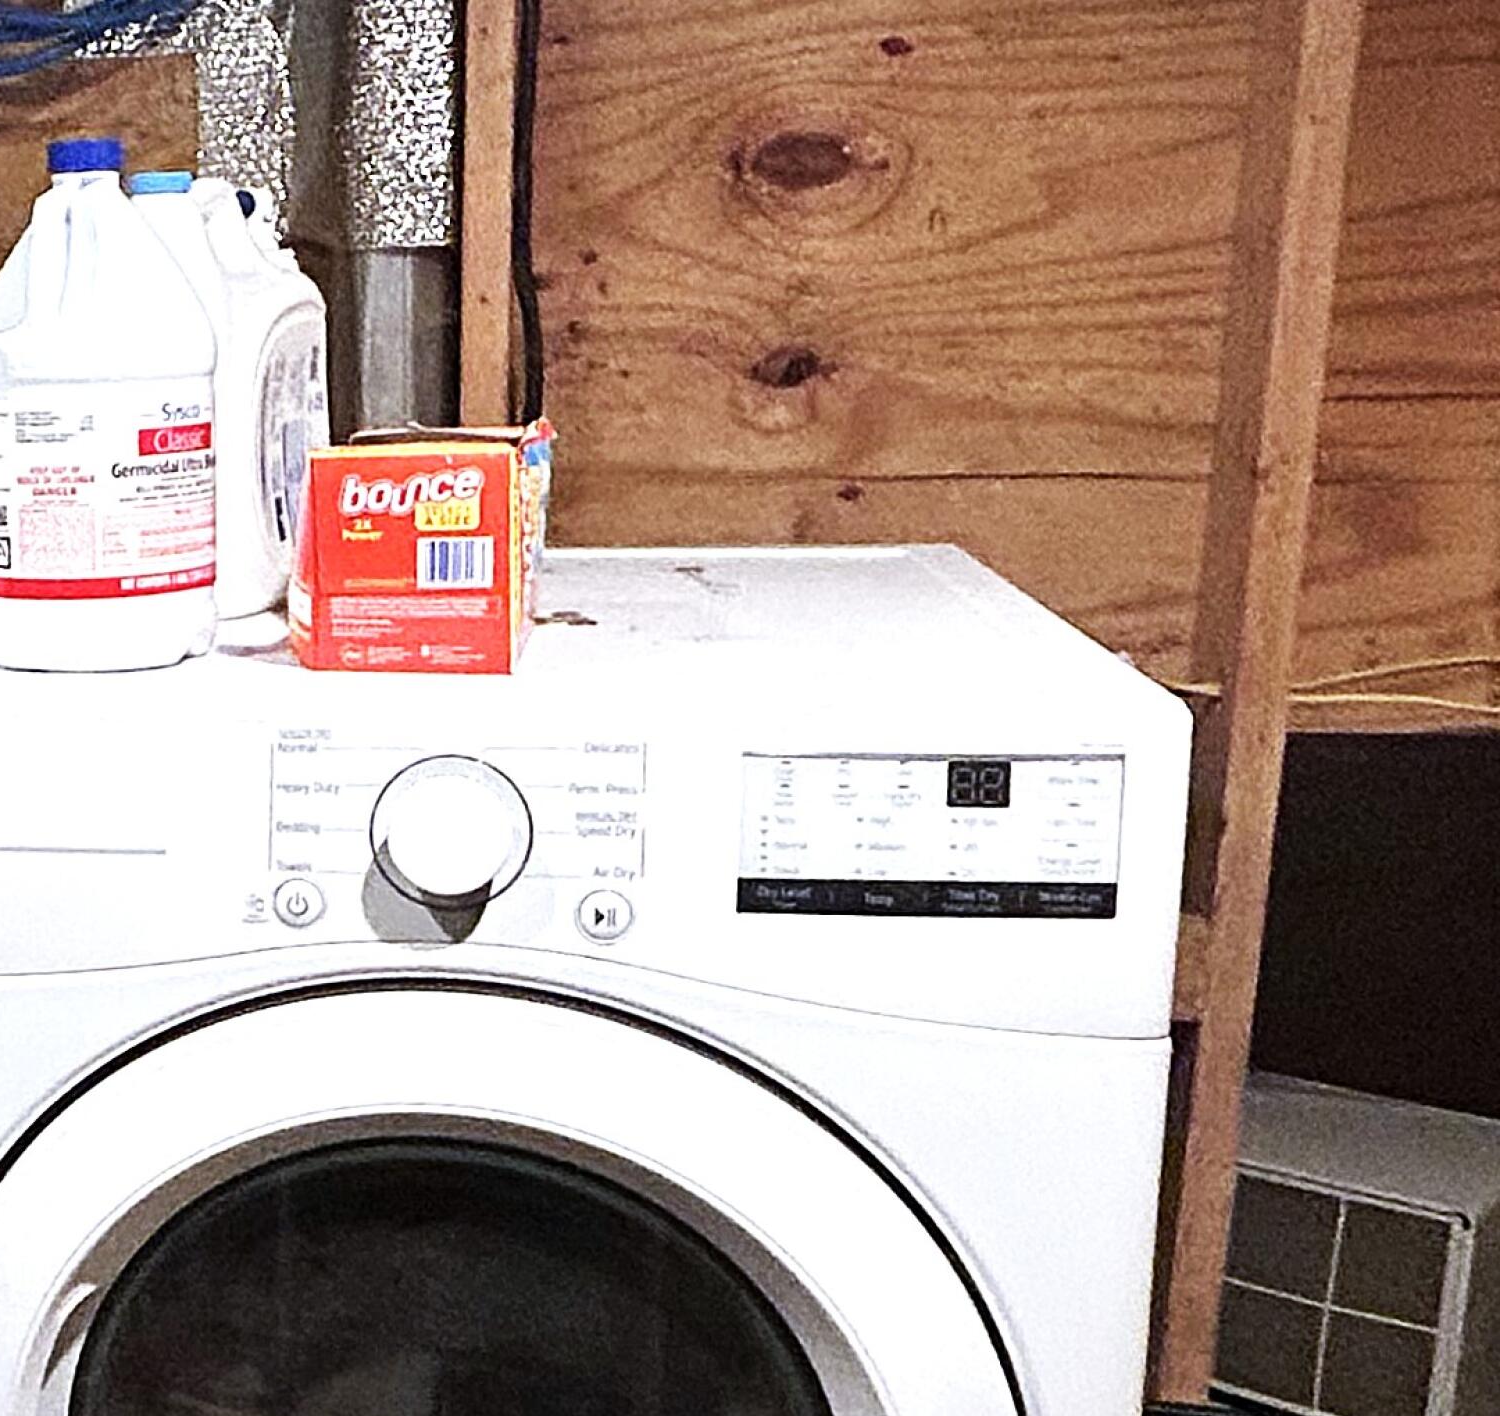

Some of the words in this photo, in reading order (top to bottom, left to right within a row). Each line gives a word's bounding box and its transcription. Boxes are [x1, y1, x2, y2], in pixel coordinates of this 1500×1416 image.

[154, 428, 205, 452] Classic
[111, 459, 179, 478] Germicidal
[342, 469, 482, 514] bounce
[613, 825, 636, 840] Dry
[612, 866, 636, 882] Dry
